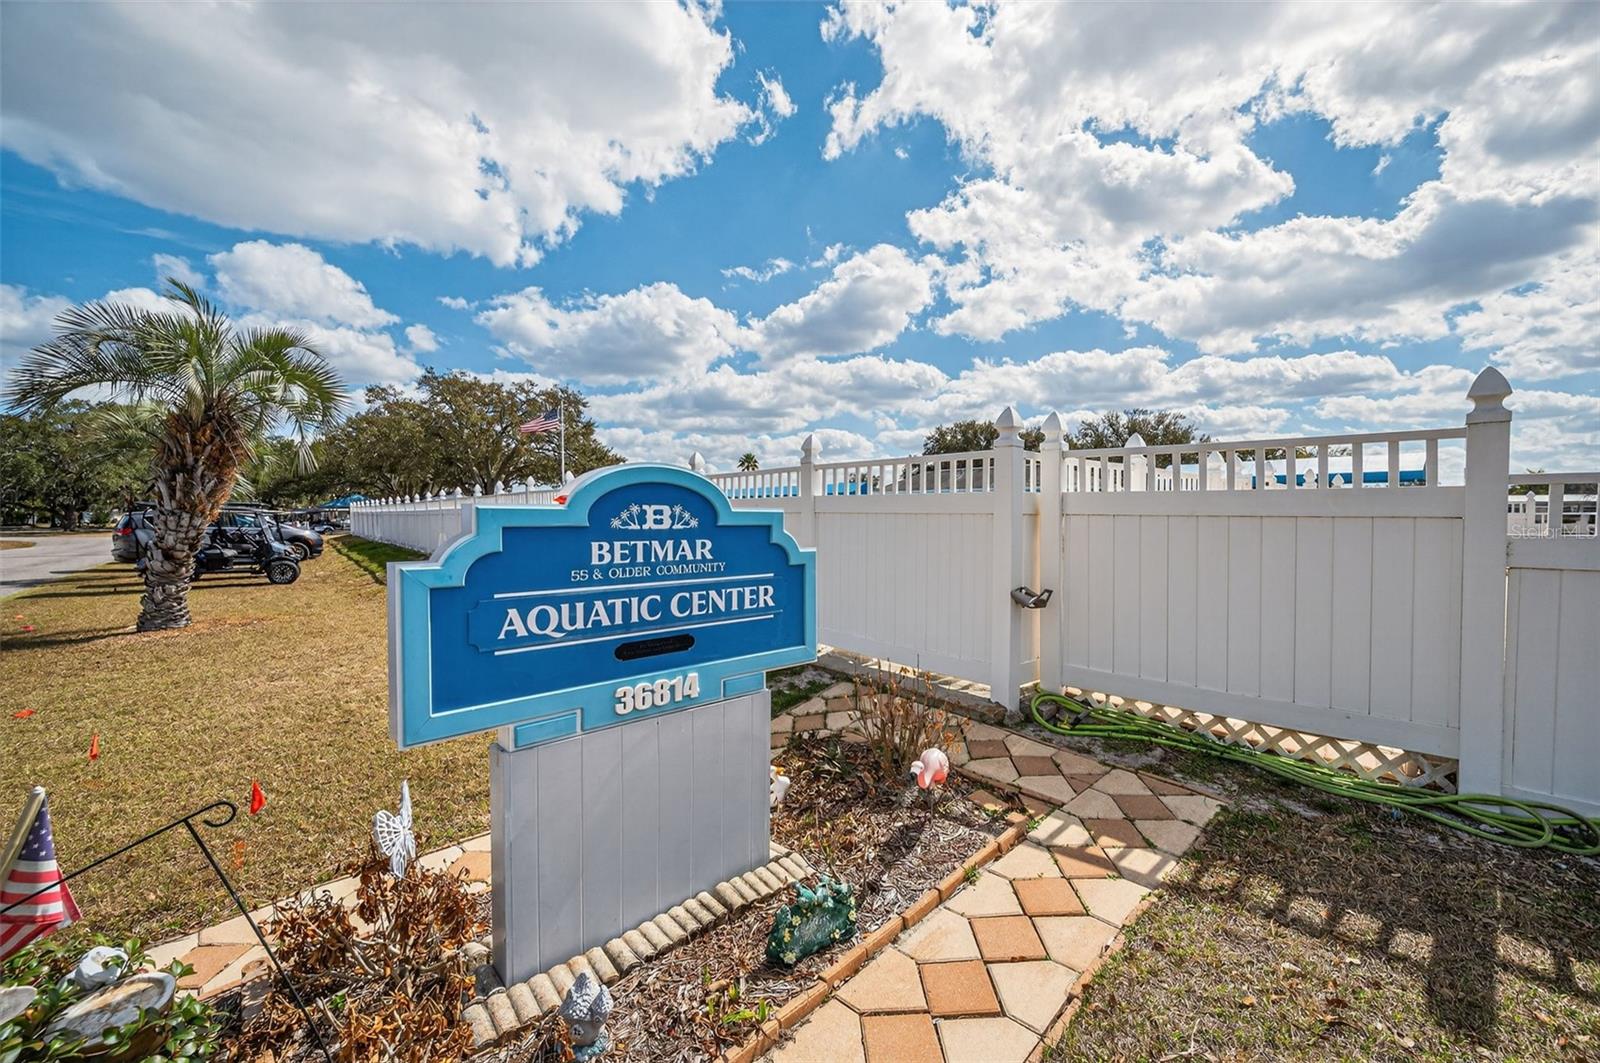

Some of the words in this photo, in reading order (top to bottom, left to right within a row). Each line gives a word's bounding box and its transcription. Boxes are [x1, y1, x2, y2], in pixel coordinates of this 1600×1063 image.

[642, 504, 672, 529] B
[590, 539, 713, 565] BETMAR
[570, 569, 589, 582] 55
[593, 569, 603, 580] &
[608, 564, 651, 578] OLDER
[656, 561, 726, 576] COMMUNITY
[498, 595, 662, 639] AQUATIC
[671, 585, 775, 617] CENTER
[615, 672, 700, 715] 36814
